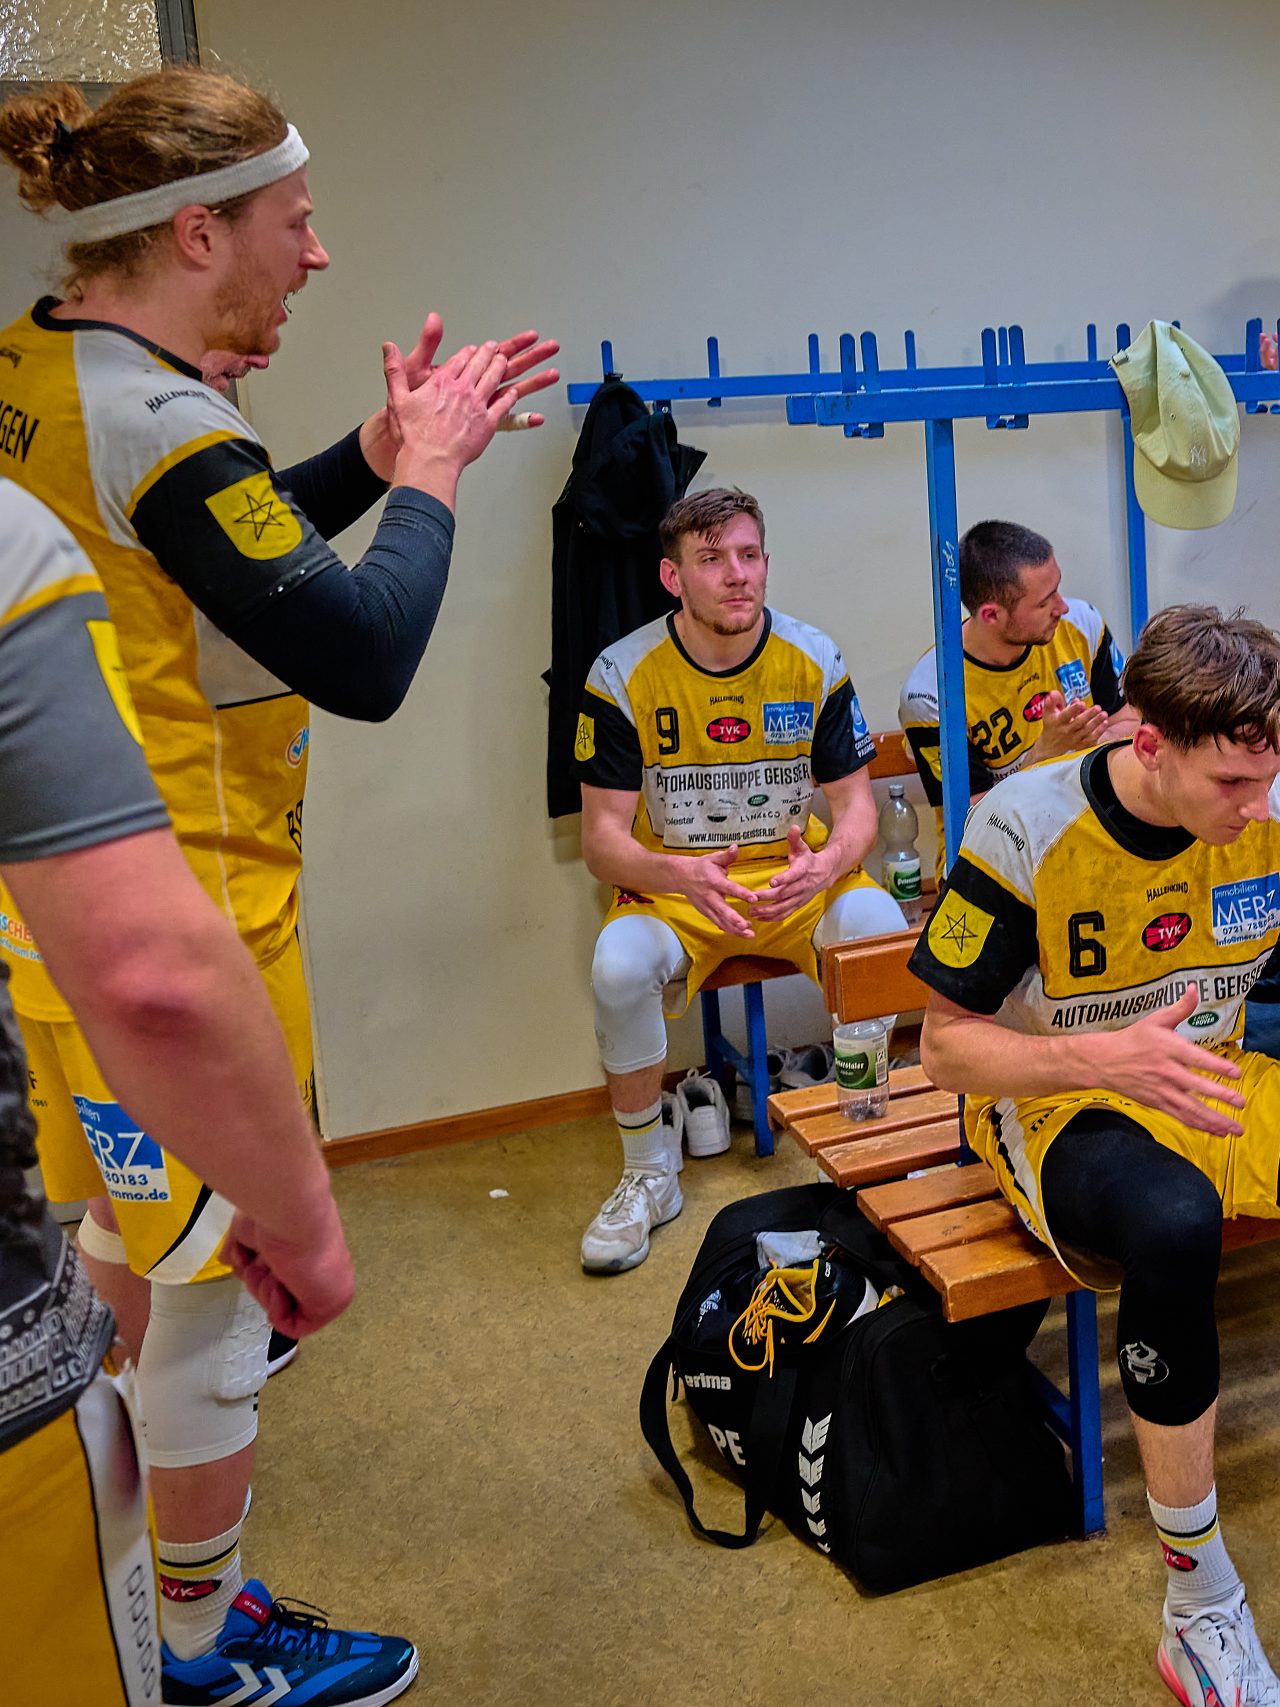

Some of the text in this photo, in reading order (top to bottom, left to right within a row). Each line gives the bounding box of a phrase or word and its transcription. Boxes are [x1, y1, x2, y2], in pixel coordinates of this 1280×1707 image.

[654, 706, 680, 756] 9
[719, 727, 741, 736] TVK
[970, 706, 1023, 761] 22
[763, 762, 811, 786] GEISSER
[986, 812, 1025, 852] HALLENKIND
[1145, 881, 1189, 904] HALLENKIND
[1214, 882, 1259, 900] Immobilien
[1158, 924, 1182, 941] TVK
[1222, 926, 1244, 936] 0721
[1067, 910, 1107, 978] 6
[1214, 960, 1268, 1000] GEISSE
[684, 1373, 732, 1391] erima
[708, 1423, 747, 1466] PE
